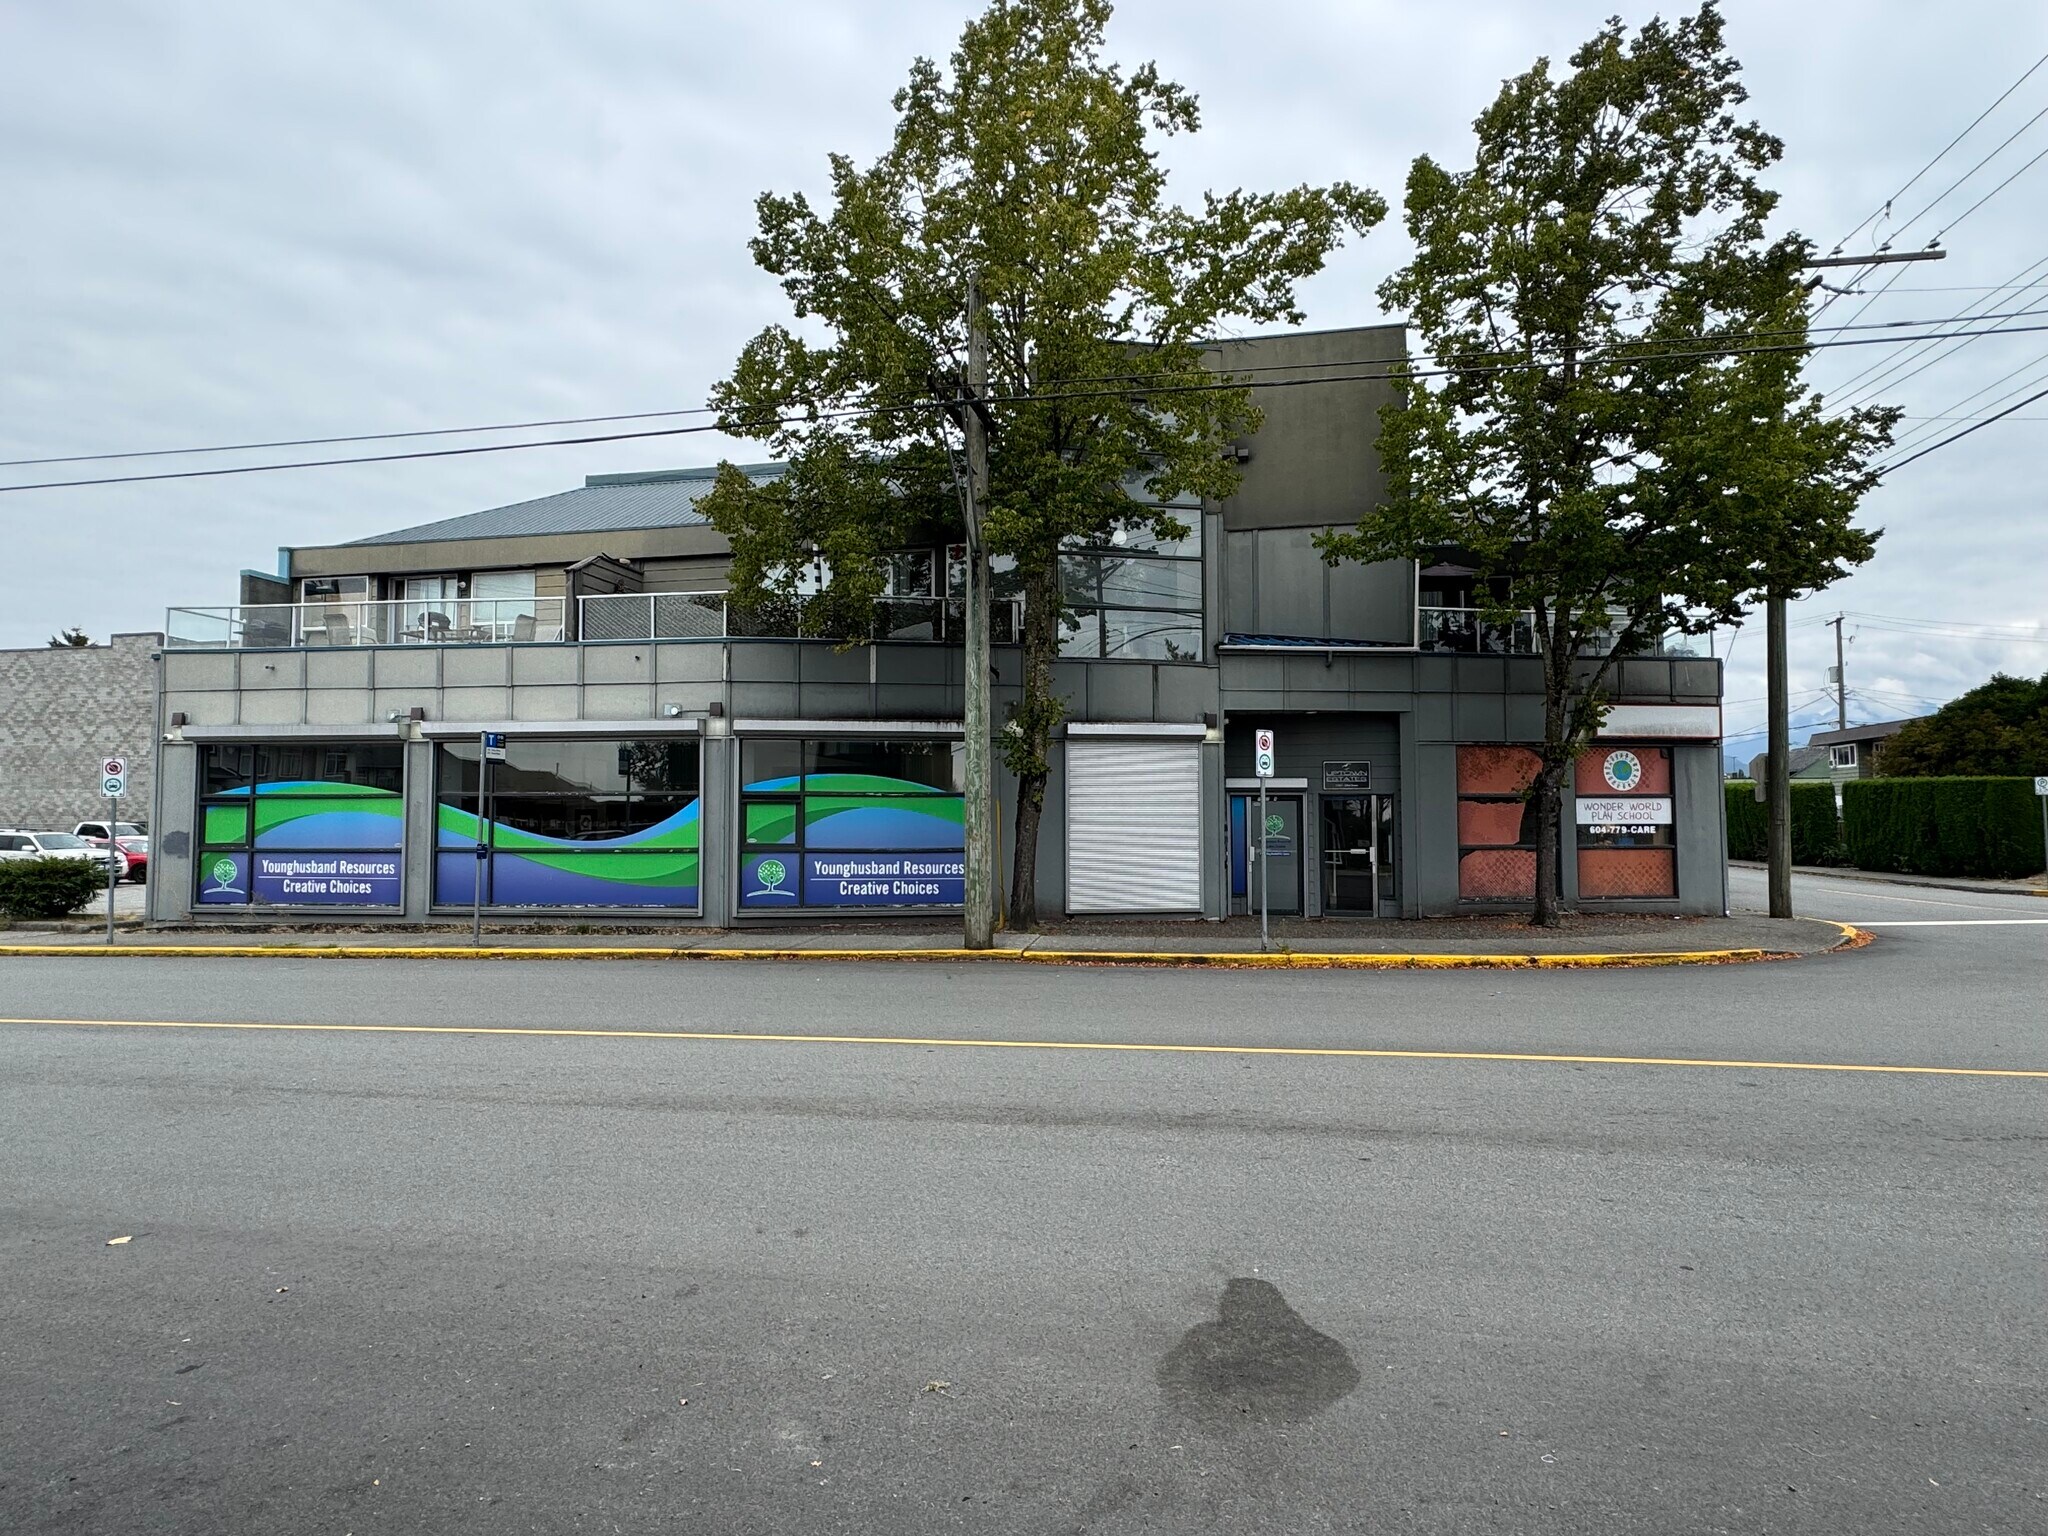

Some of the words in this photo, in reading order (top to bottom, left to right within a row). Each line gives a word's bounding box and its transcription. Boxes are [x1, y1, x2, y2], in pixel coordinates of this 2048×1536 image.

[488, 734, 495, 746] T
[1583, 802, 1625, 811] WONDER
[1629, 802, 1663, 811] WORLD
[1591, 811, 1613, 821] PLAY
[1617, 811, 1655, 820] SCHOOL
[1589, 825, 1657, 834] 604-779-CARE
[261, 859, 337, 876] Younghusband
[339, 860, 396, 875] Resources
[814, 860, 900, 877] Younghusband
[903, 860, 965, 875] Resources
[283, 879, 327, 893] Creative
[329, 880, 372, 894] Choices
[839, 881, 889, 895] Creative
[893, 881, 939, 895] Choices
